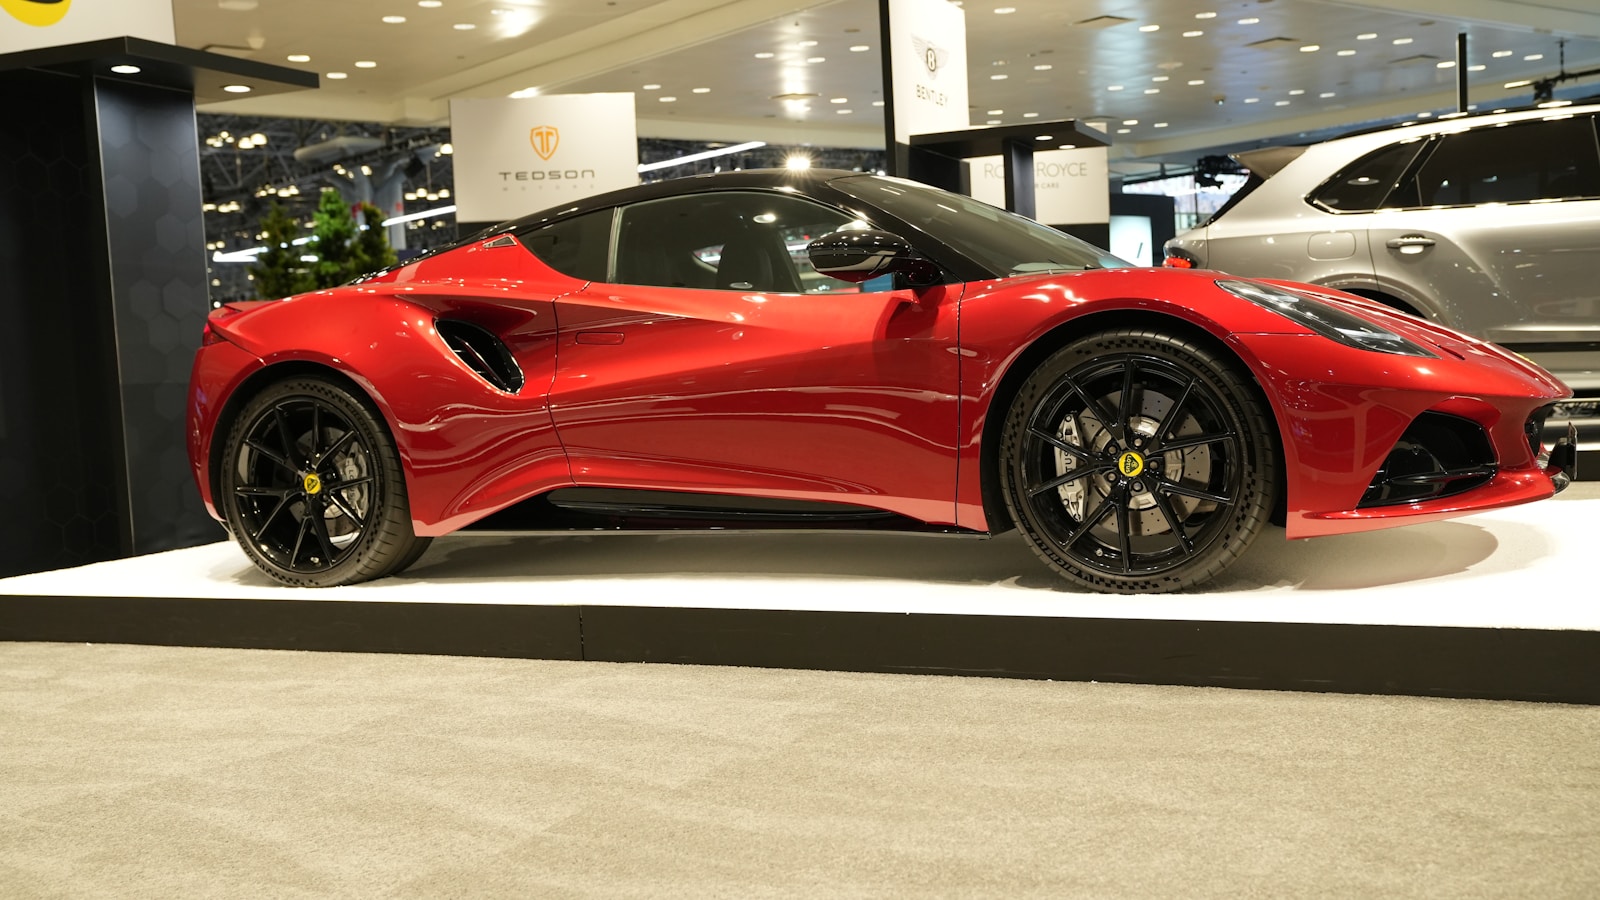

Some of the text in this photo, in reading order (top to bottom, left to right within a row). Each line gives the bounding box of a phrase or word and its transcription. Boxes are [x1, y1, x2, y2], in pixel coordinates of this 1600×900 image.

[916, 84, 949, 108] BENTLEY
[498, 169, 596, 181] TEDSON
[1064, 451, 1075, 487] LTUS
[1028, 529, 1079, 577] MICHELIN
